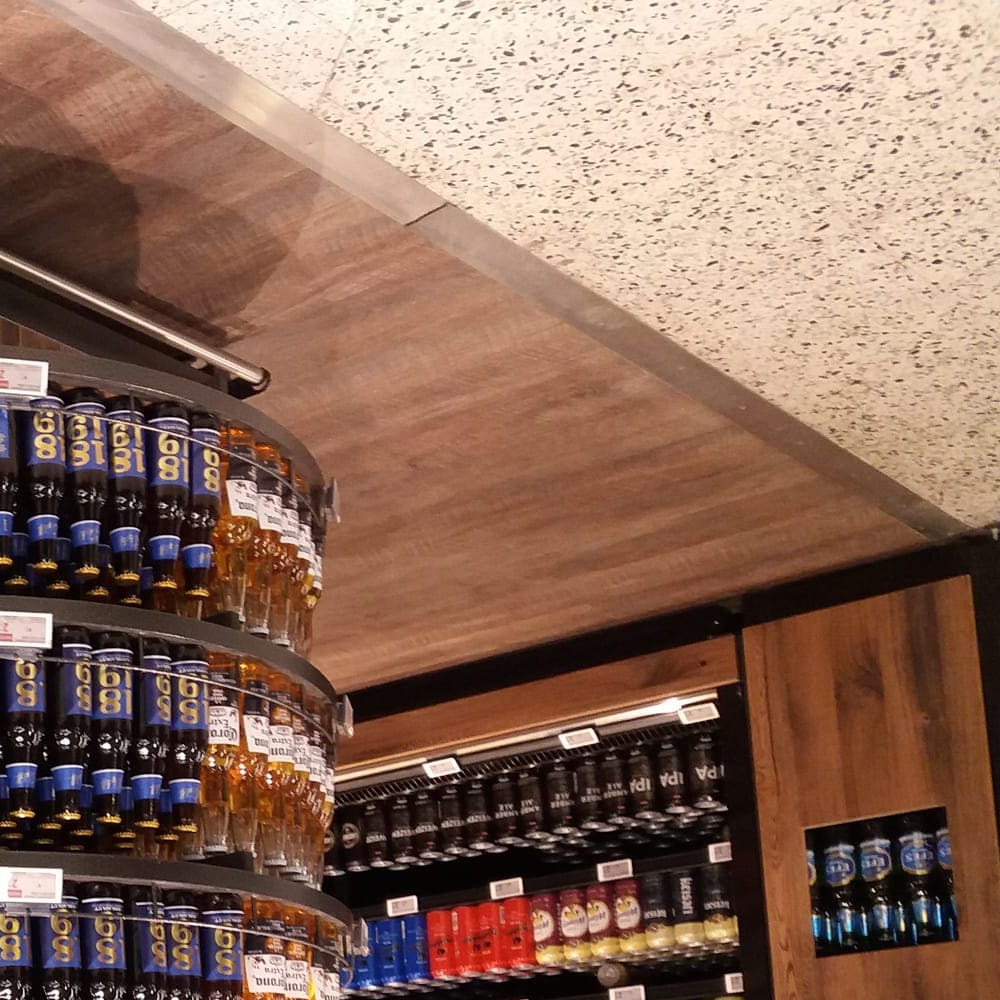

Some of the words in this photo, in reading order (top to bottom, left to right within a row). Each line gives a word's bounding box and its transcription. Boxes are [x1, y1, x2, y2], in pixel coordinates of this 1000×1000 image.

[68, 415, 103, 441] 19
[111, 422, 144, 448] 19
[70, 440, 105, 467] 18
[112, 447, 145, 473] 18
[98, 663, 132, 688] 19
[99, 688, 132, 714] 18
[210, 728, 237, 740] Coro
[629, 777, 651, 794] IPA
[659, 771, 684, 788] IPA
